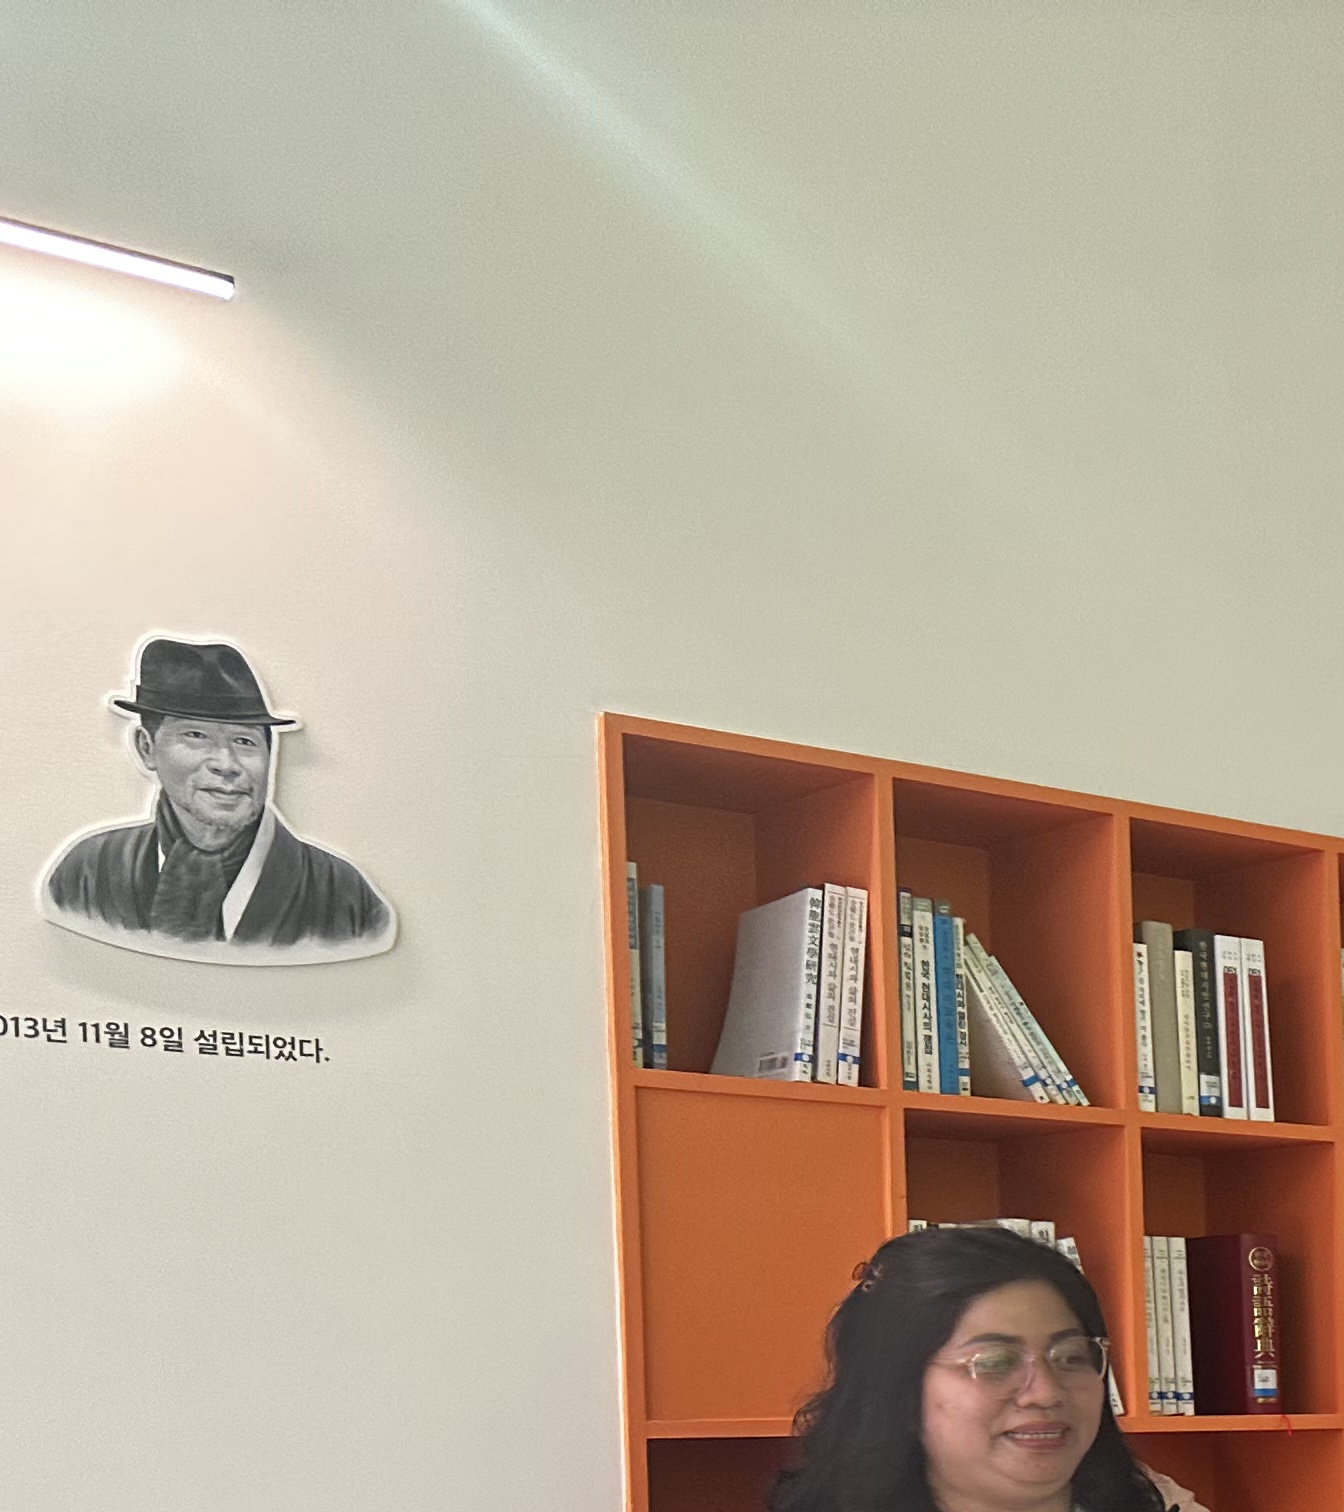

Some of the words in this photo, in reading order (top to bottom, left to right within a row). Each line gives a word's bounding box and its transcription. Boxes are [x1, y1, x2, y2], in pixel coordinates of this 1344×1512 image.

[78, 1022, 130, 1049] 11월
[140, 1025, 185, 1053] 8일
[193, 1029, 331, 1063] 설립되었다.
